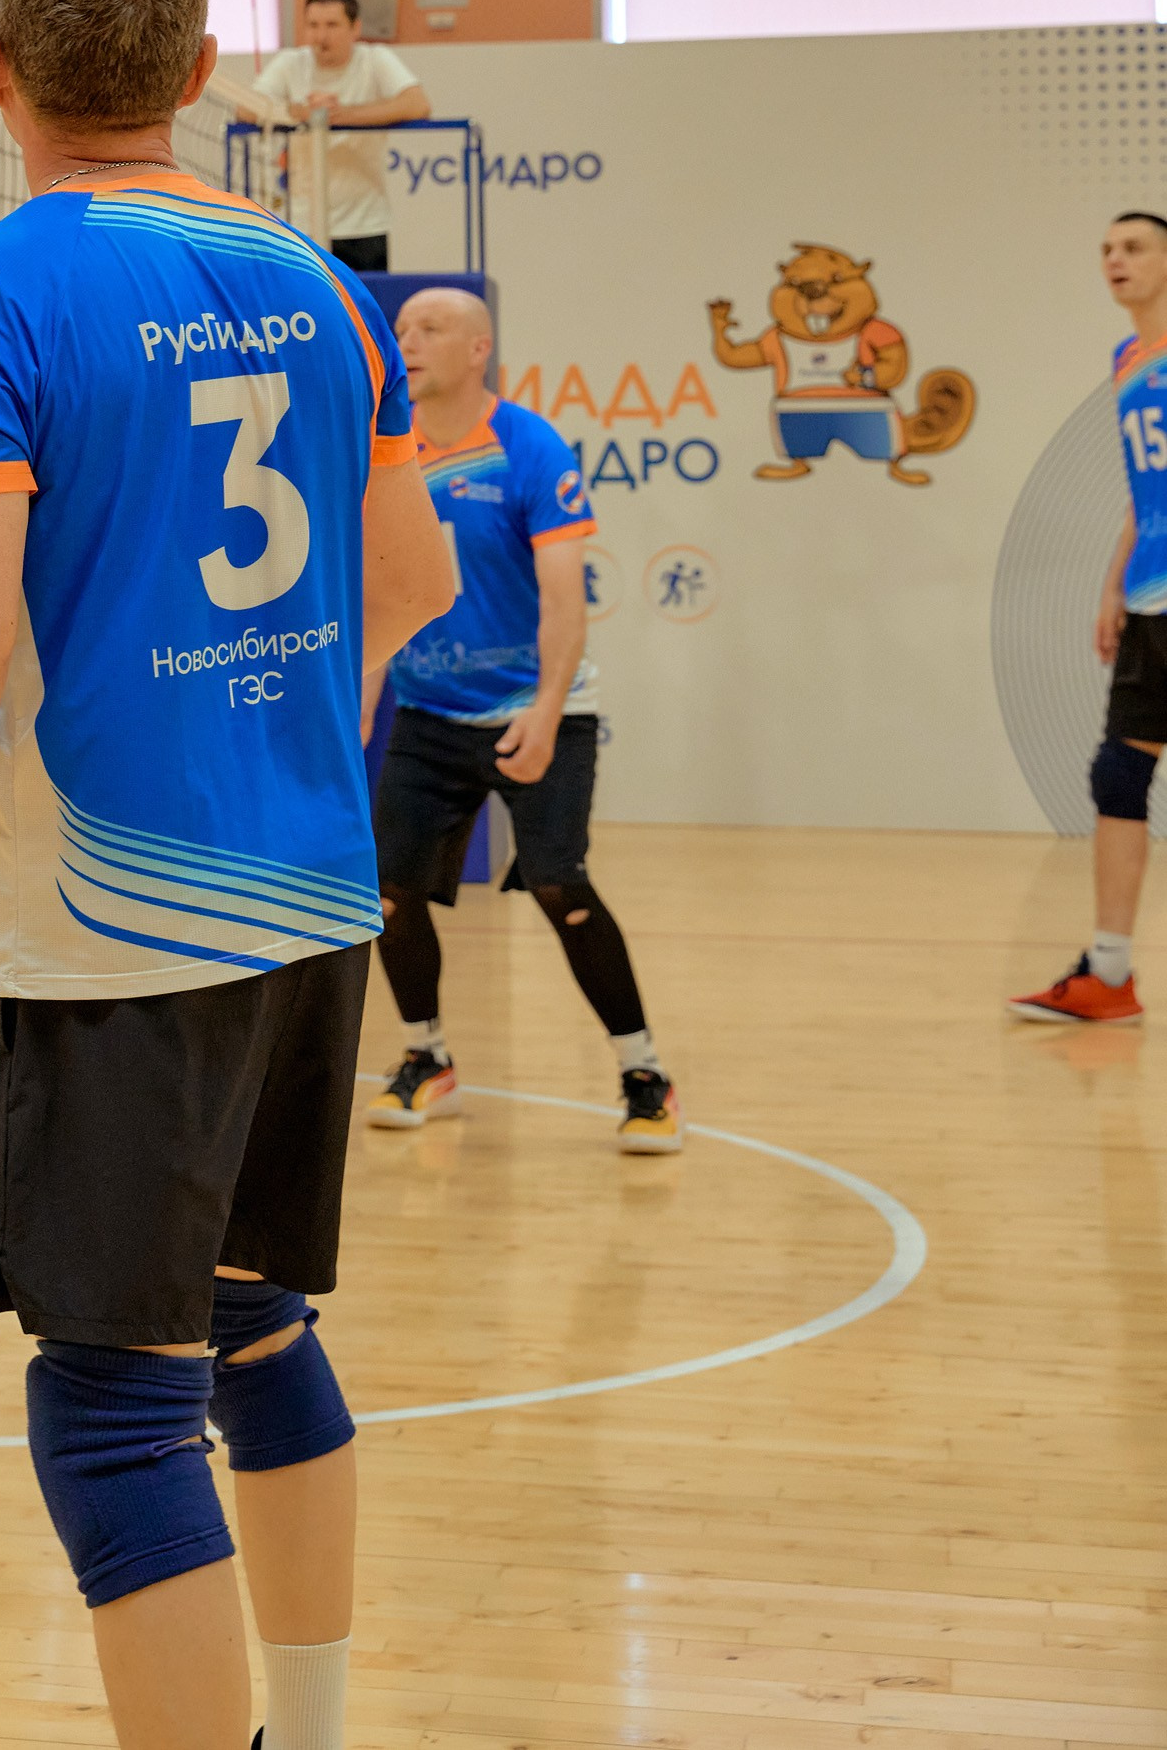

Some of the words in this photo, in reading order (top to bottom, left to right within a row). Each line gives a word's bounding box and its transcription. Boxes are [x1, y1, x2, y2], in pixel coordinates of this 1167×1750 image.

[138, 311, 316, 365] РусГидро
[1123, 407, 1167, 472] 15
[190, 371, 310, 611] 3
[152, 621, 338, 678] Новосибирскя
[228, 671, 284, 708] ГЭС
